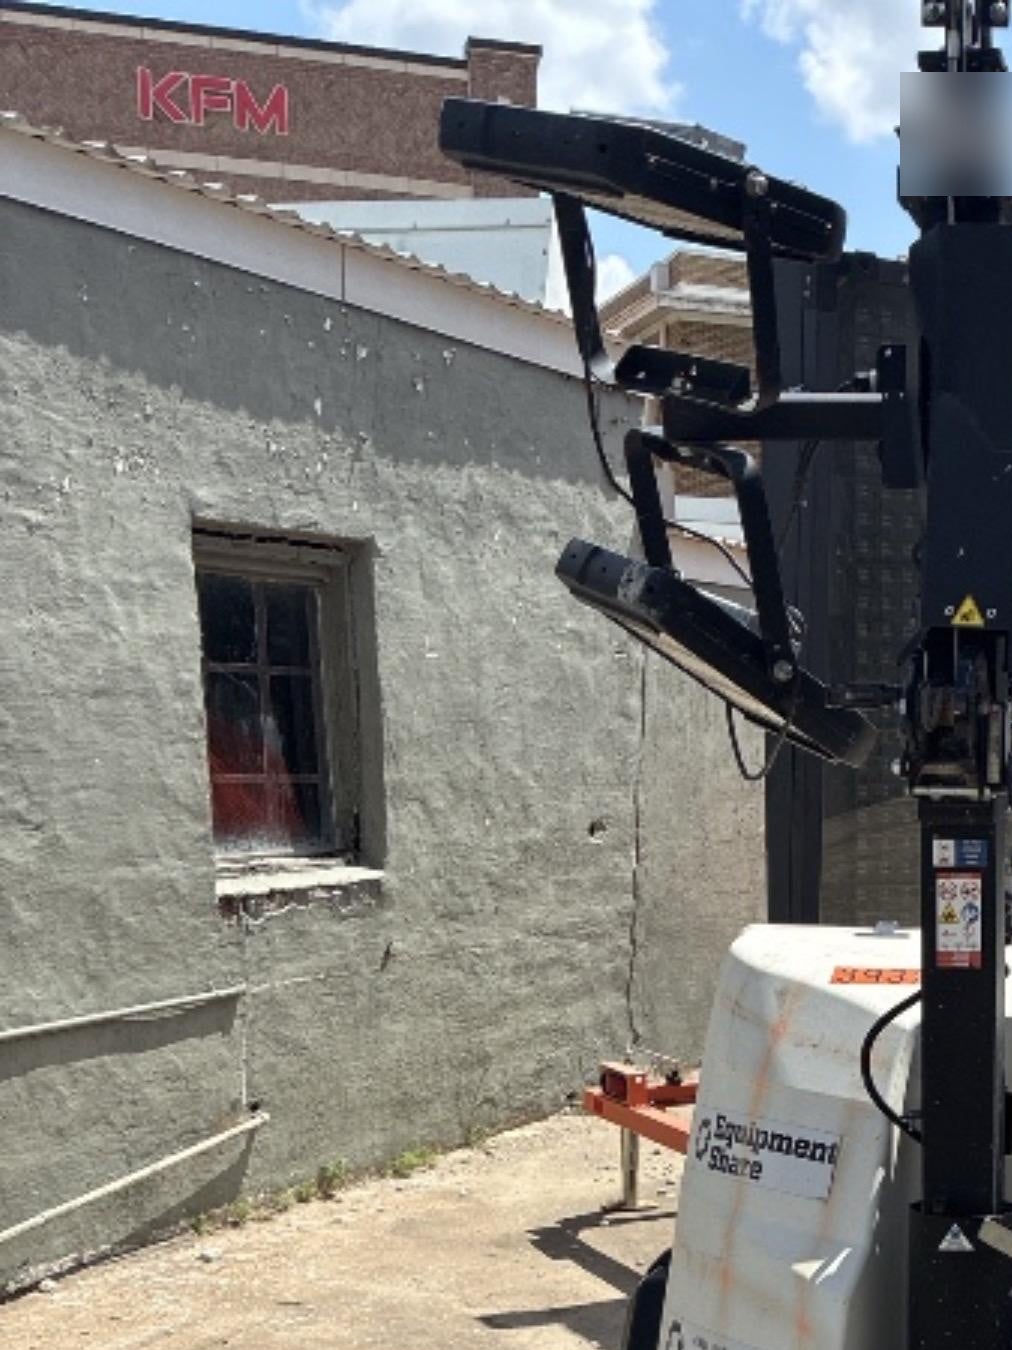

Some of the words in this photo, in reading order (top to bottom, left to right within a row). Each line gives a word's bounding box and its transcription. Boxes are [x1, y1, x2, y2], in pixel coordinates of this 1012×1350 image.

[137, 65, 289, 136] KFM
[708, 1145, 763, 1181] Share
[713, 1112, 838, 1165] Equipment
